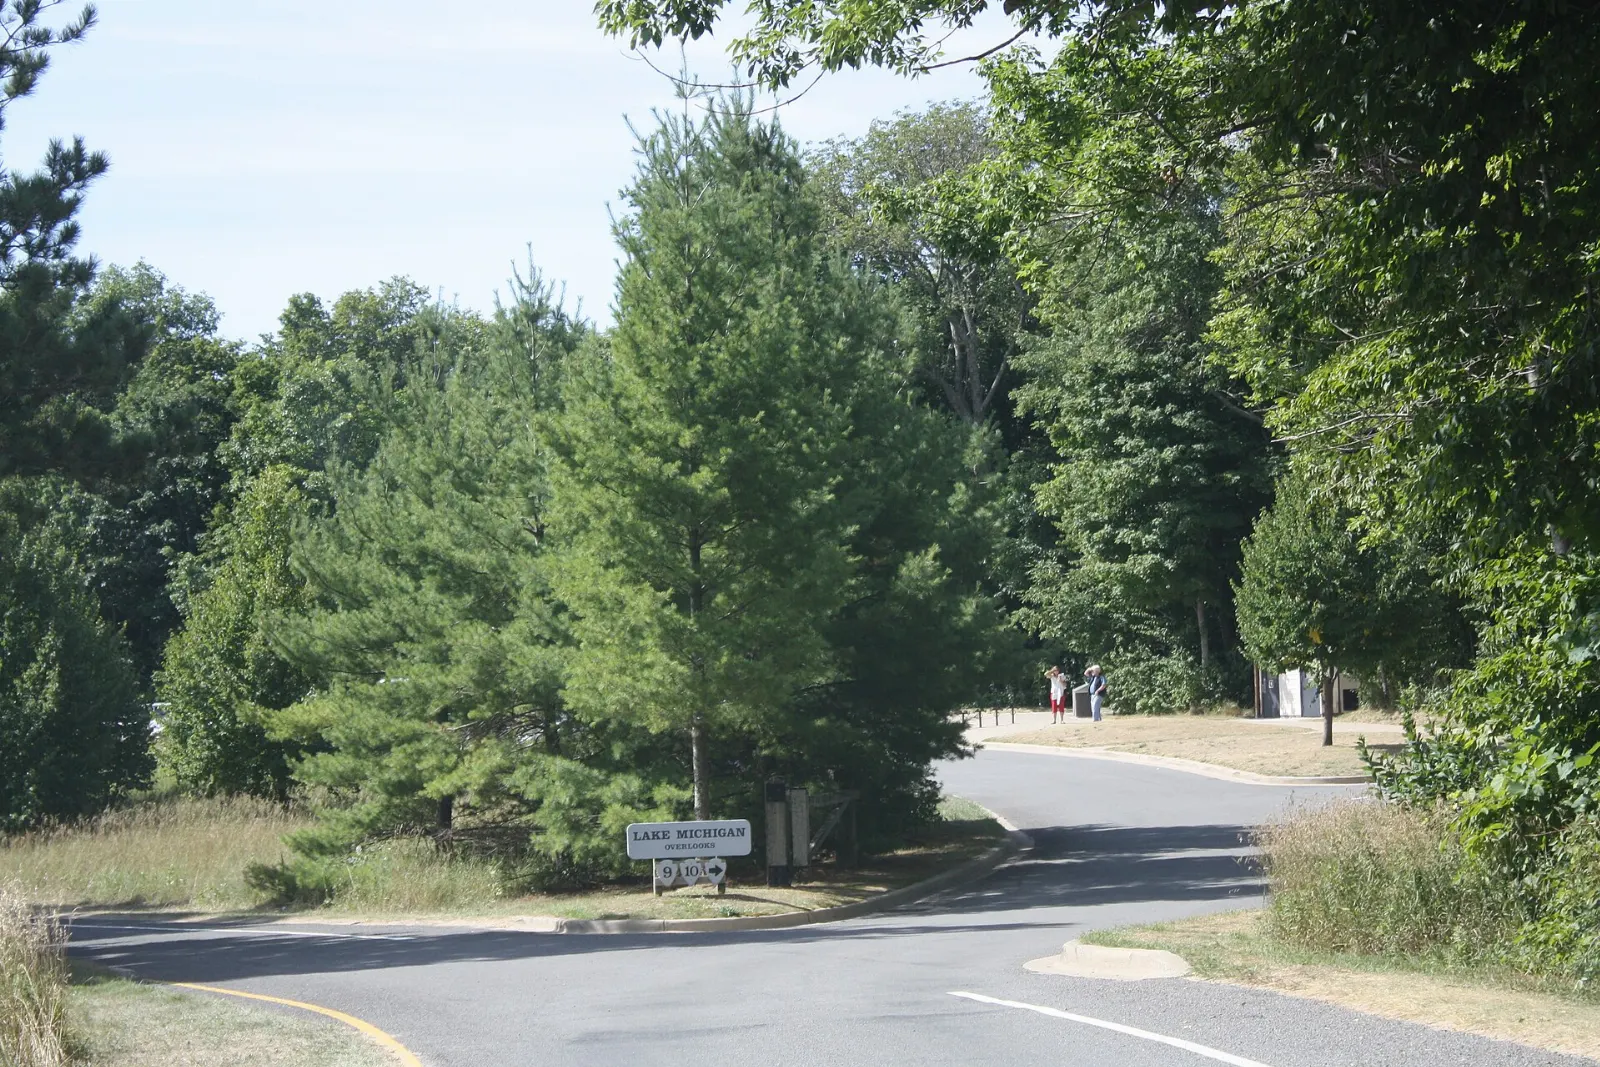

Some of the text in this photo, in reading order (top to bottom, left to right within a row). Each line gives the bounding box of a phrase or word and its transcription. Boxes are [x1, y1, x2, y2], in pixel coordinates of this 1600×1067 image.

[633, 827, 746, 841] LAKE MICHIGAN
[664, 842, 716, 851] OVERLOOKS
[662, 865, 699, 878] 9 10
